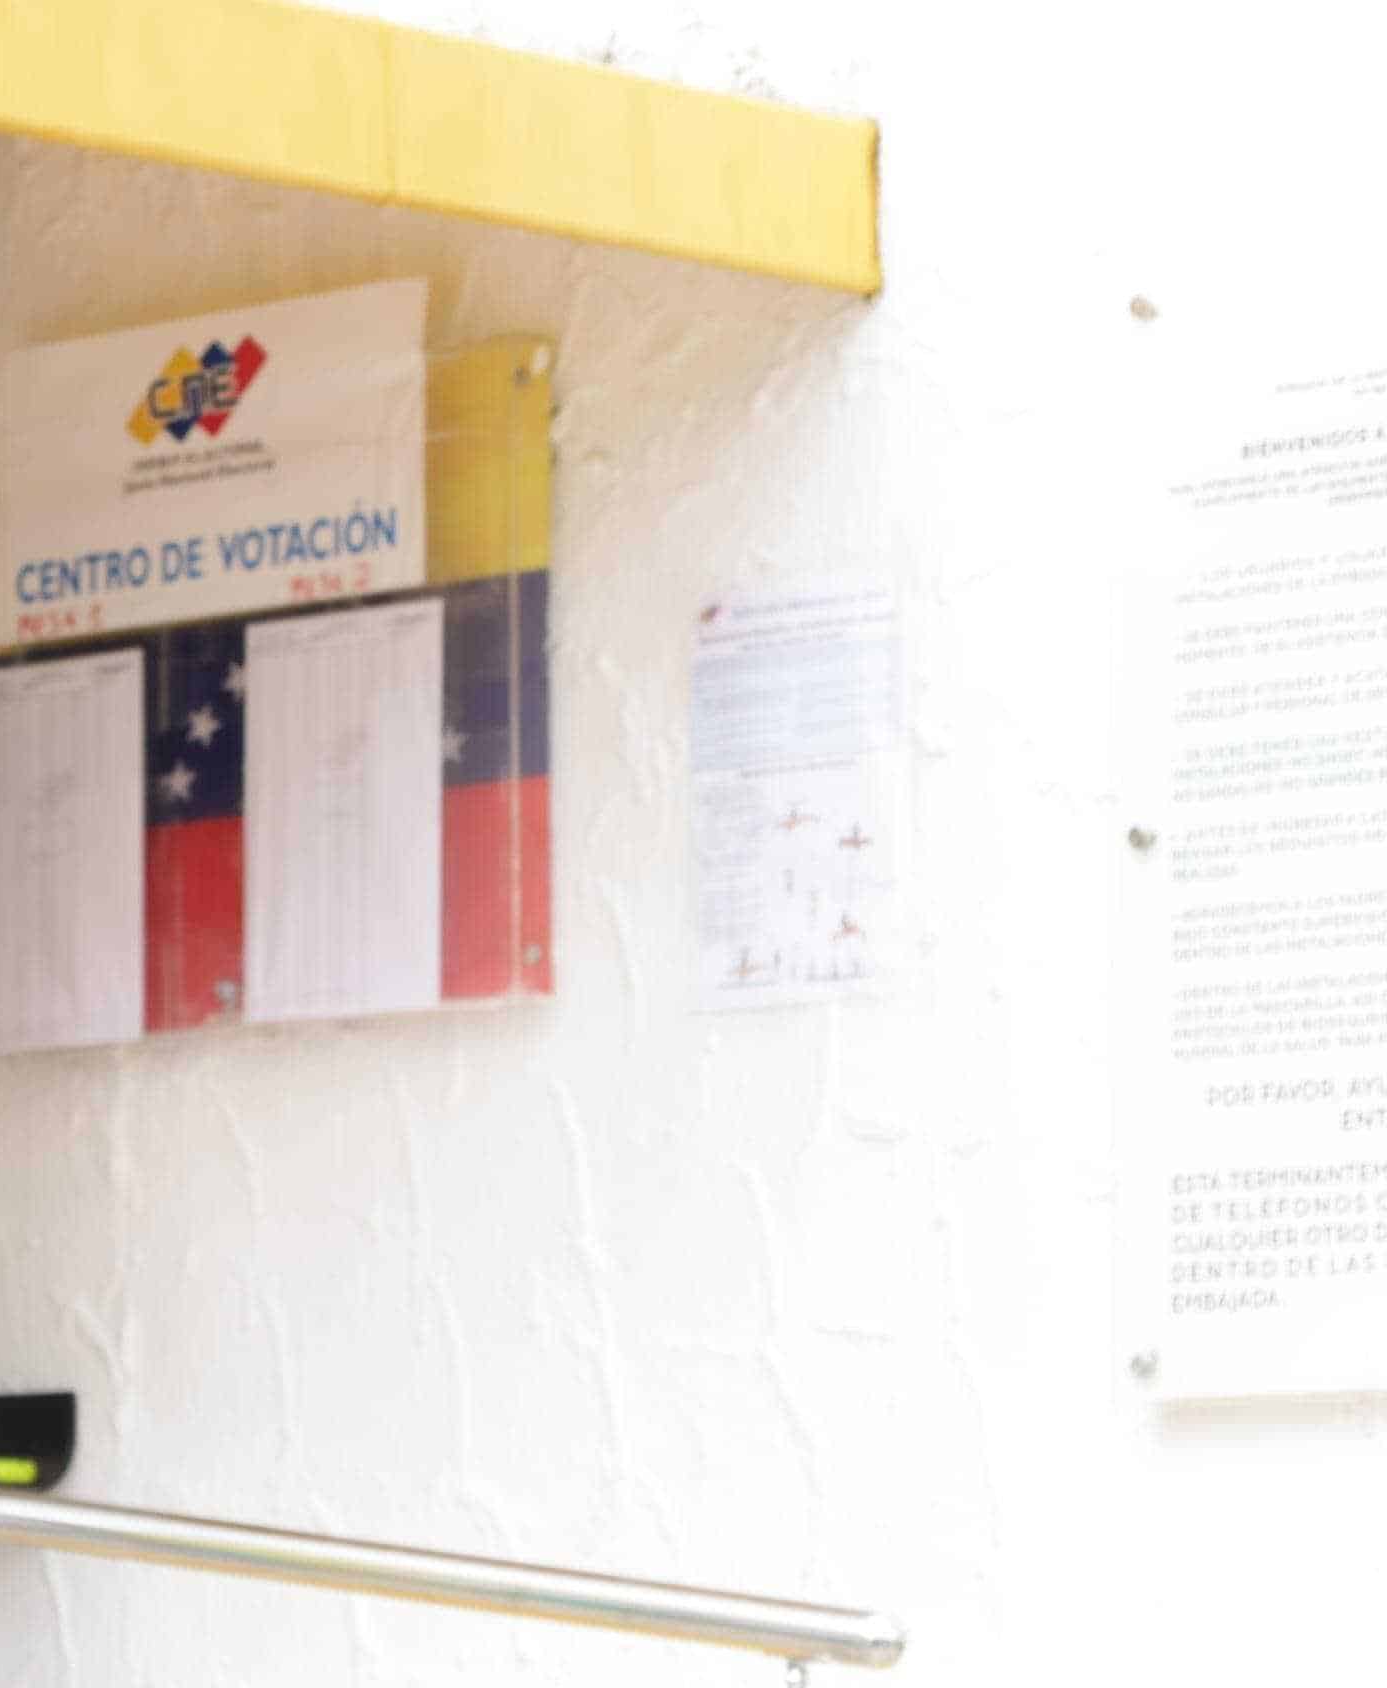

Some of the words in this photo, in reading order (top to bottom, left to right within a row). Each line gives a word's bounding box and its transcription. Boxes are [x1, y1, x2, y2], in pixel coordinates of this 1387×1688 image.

[17, 545, 151, 606] CENTRO
[162, 538, 204, 582] DE
[218, 502, 399, 577] VOTACIÓN
[1205, 1082, 1255, 1107] POR
[1170, 1200, 1203, 1225] DE
[1170, 1226, 1298, 1255] CUALQUIER
[1303, 1221, 1369, 1247] OTRO
[1170, 1258, 1278, 1285] DENTRO
[1285, 1255, 1319, 1278] DE
[1328, 1251, 1377, 1276] LAS
